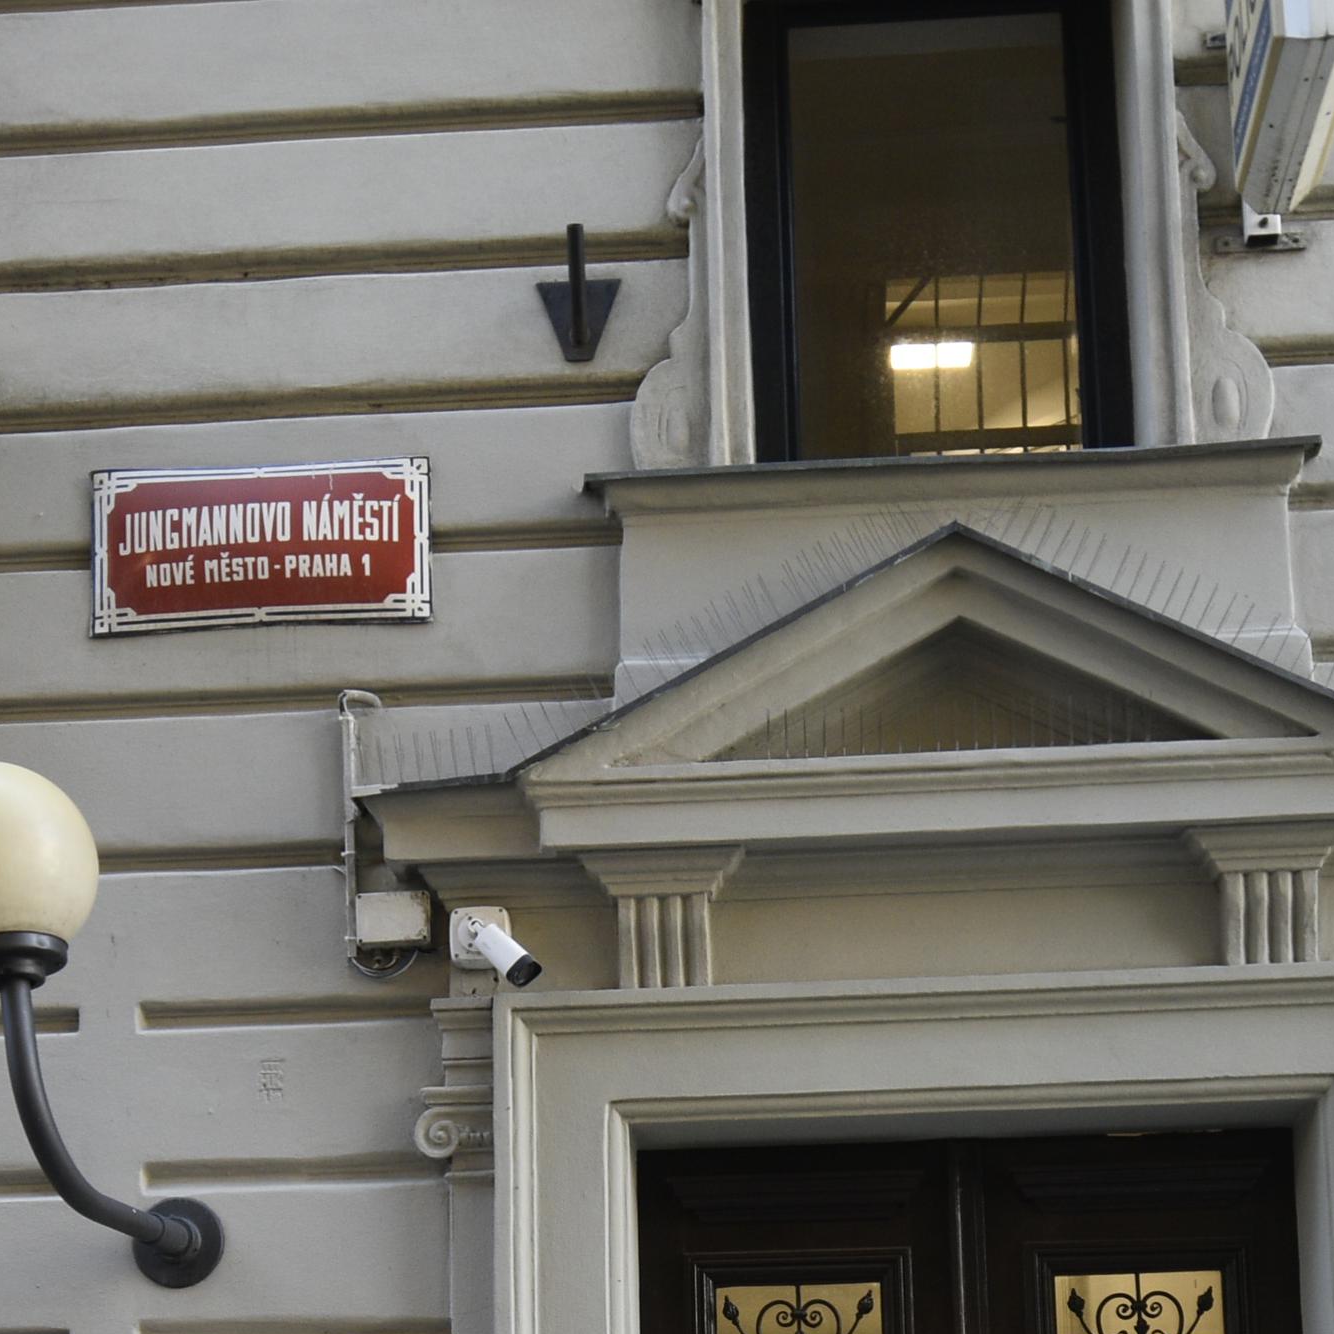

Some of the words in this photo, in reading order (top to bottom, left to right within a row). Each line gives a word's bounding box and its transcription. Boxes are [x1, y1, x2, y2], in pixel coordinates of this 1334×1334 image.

[119, 501, 291, 556] JUNGMANNOVO
[303, 493, 401, 542] NÁMĚSTÍ
[146, 554, 195, 588] NOVÉ
[204, 552, 269, 584] MĚSTO
[285, 554, 352, 578] PRAHA
[362, 553, 371, 577] 1
